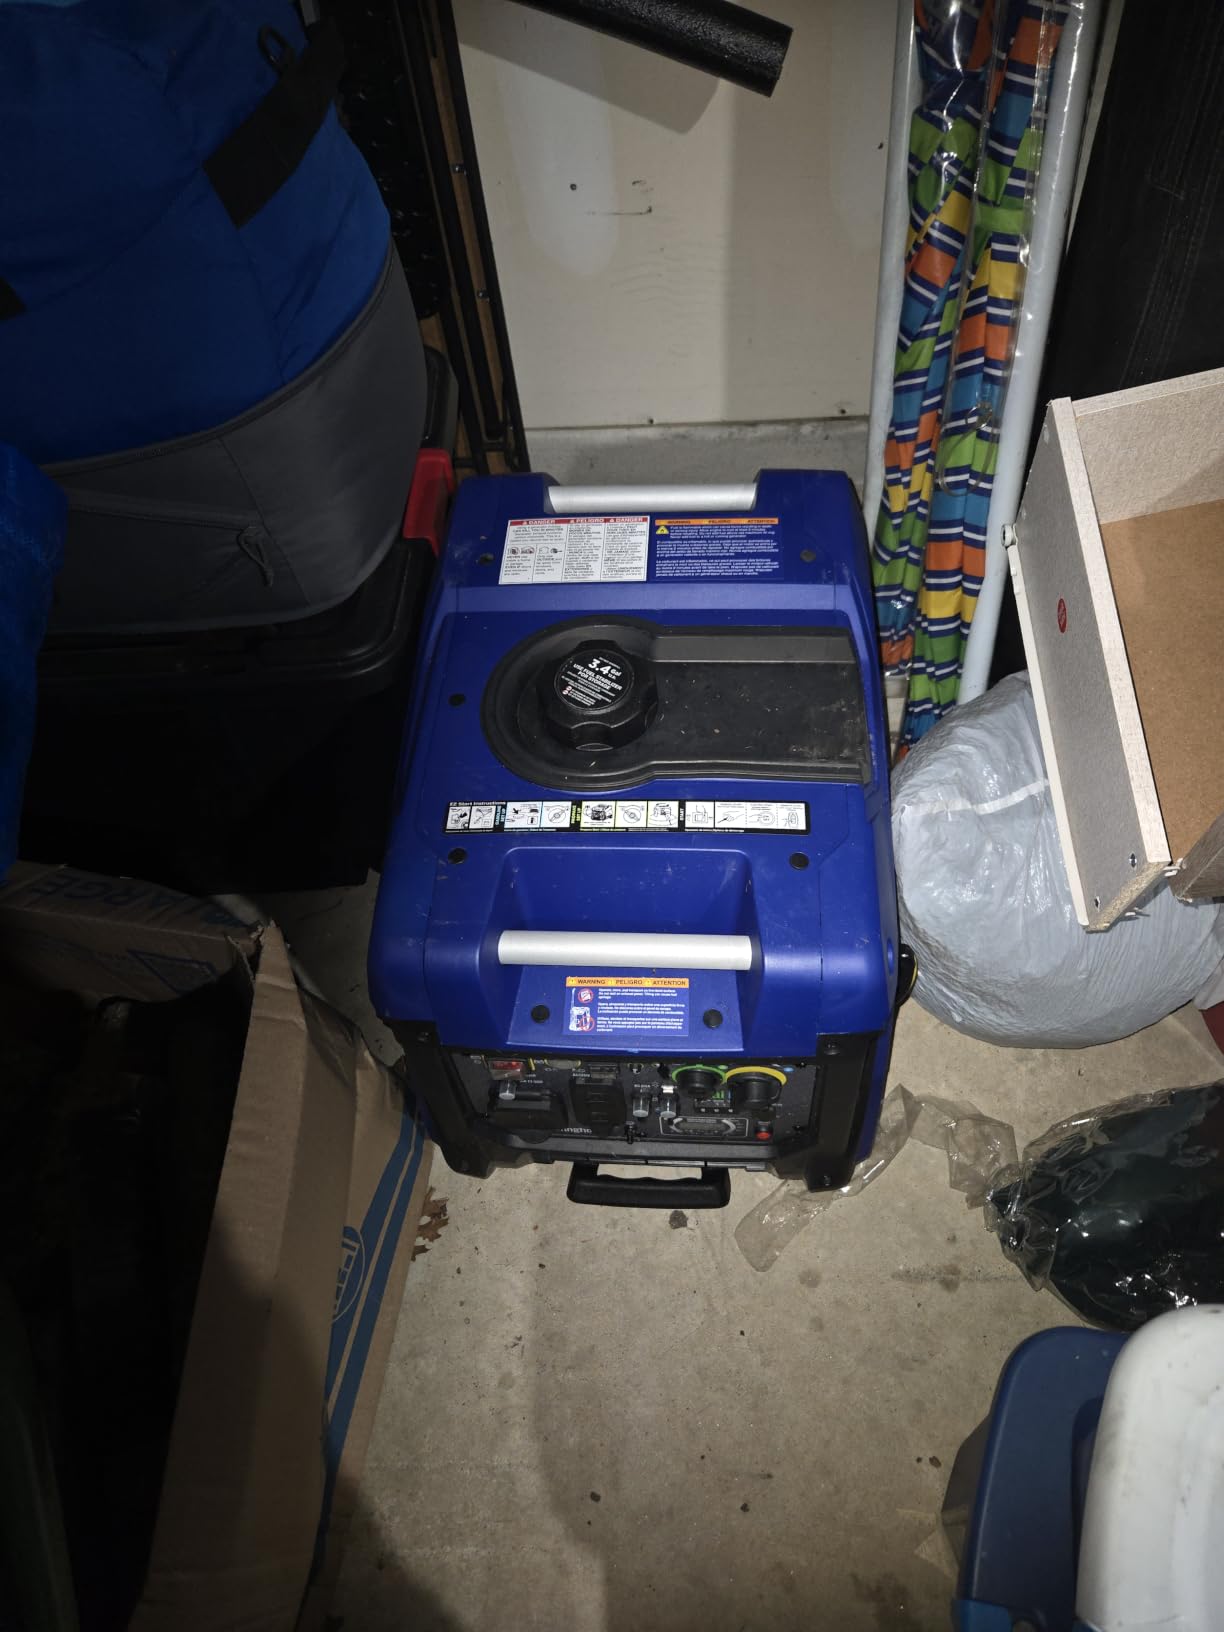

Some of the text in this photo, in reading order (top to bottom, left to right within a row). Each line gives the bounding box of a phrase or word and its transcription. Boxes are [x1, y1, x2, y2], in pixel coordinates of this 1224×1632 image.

[573, 663, 623, 691] USE FUEL STABILIZER
[588, 658, 611, 675] 3.4
[610, 668, 622, 677] Gal
[577, 671, 589, 679] FOR
[588, 676, 611, 690] STORAGE
